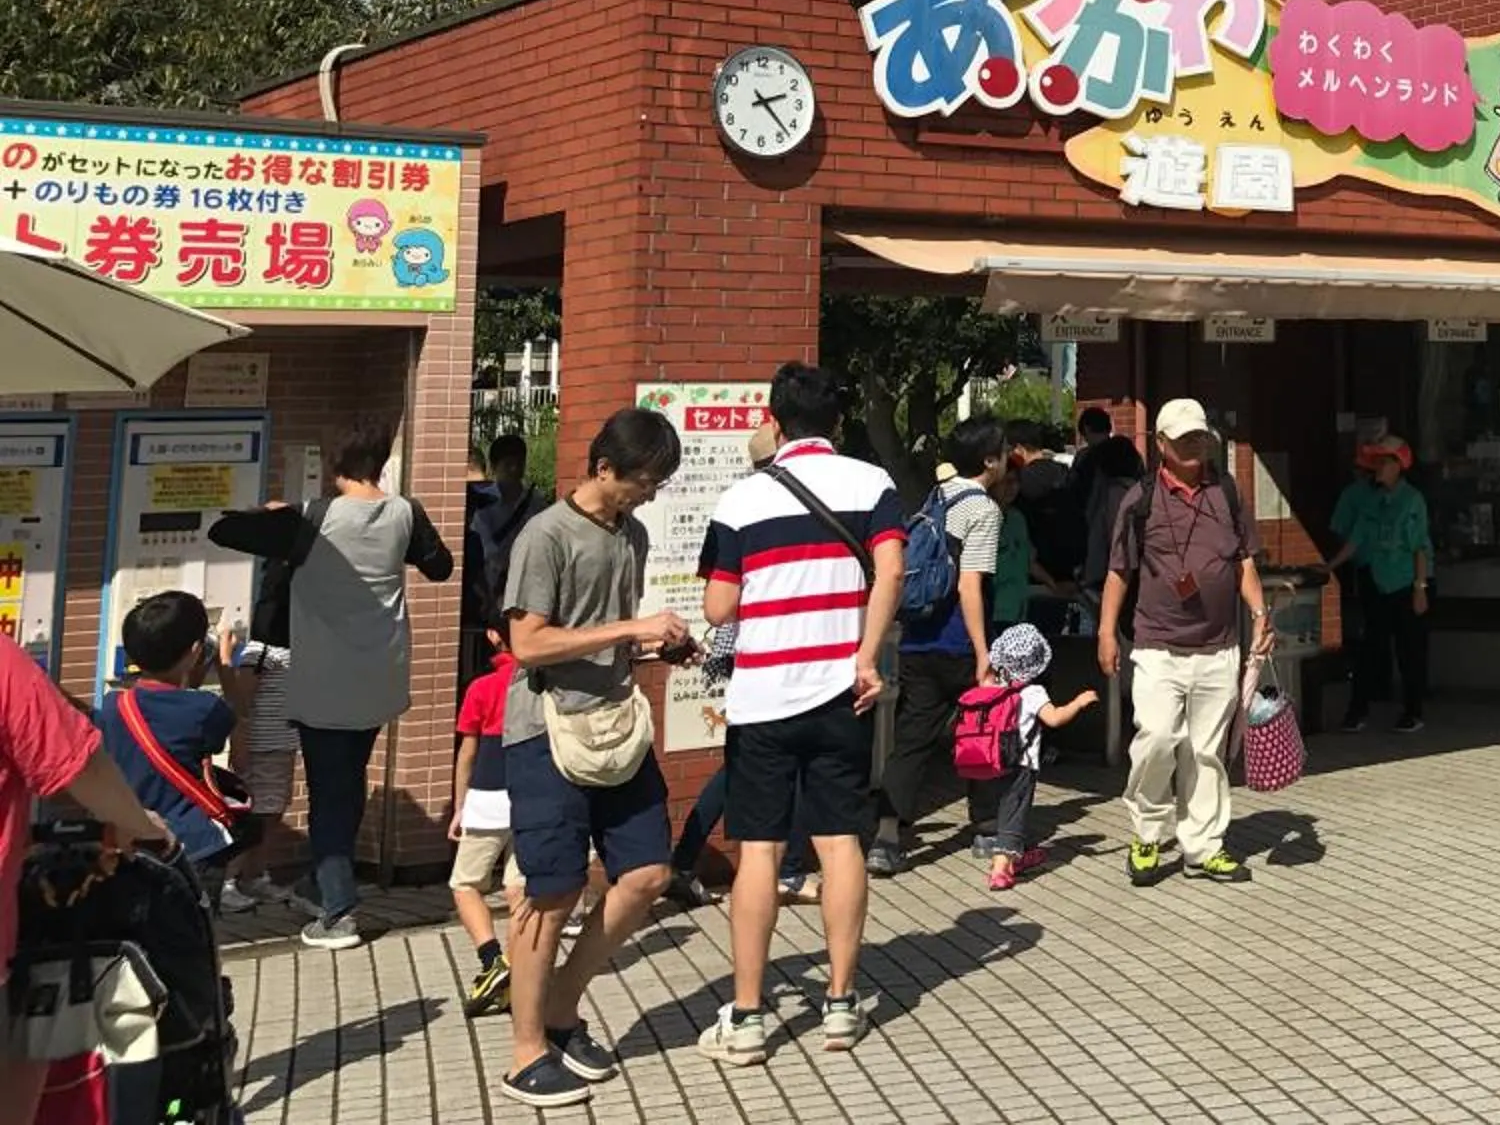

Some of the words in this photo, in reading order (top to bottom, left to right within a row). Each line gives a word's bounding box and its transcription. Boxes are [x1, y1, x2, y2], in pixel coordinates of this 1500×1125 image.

[1299, 31, 1393, 63] わくわく
[1298, 67, 1458, 106] メルヘンランド
[1146, 108, 1265, 131] ゆうえん
[1120, 133, 1294, 212] 遊園
[1055, 326, 1104, 339] ENTRANCE
[1216, 326, 1264, 338] ENTRANCE
[694, 407, 765, 429] セット券
